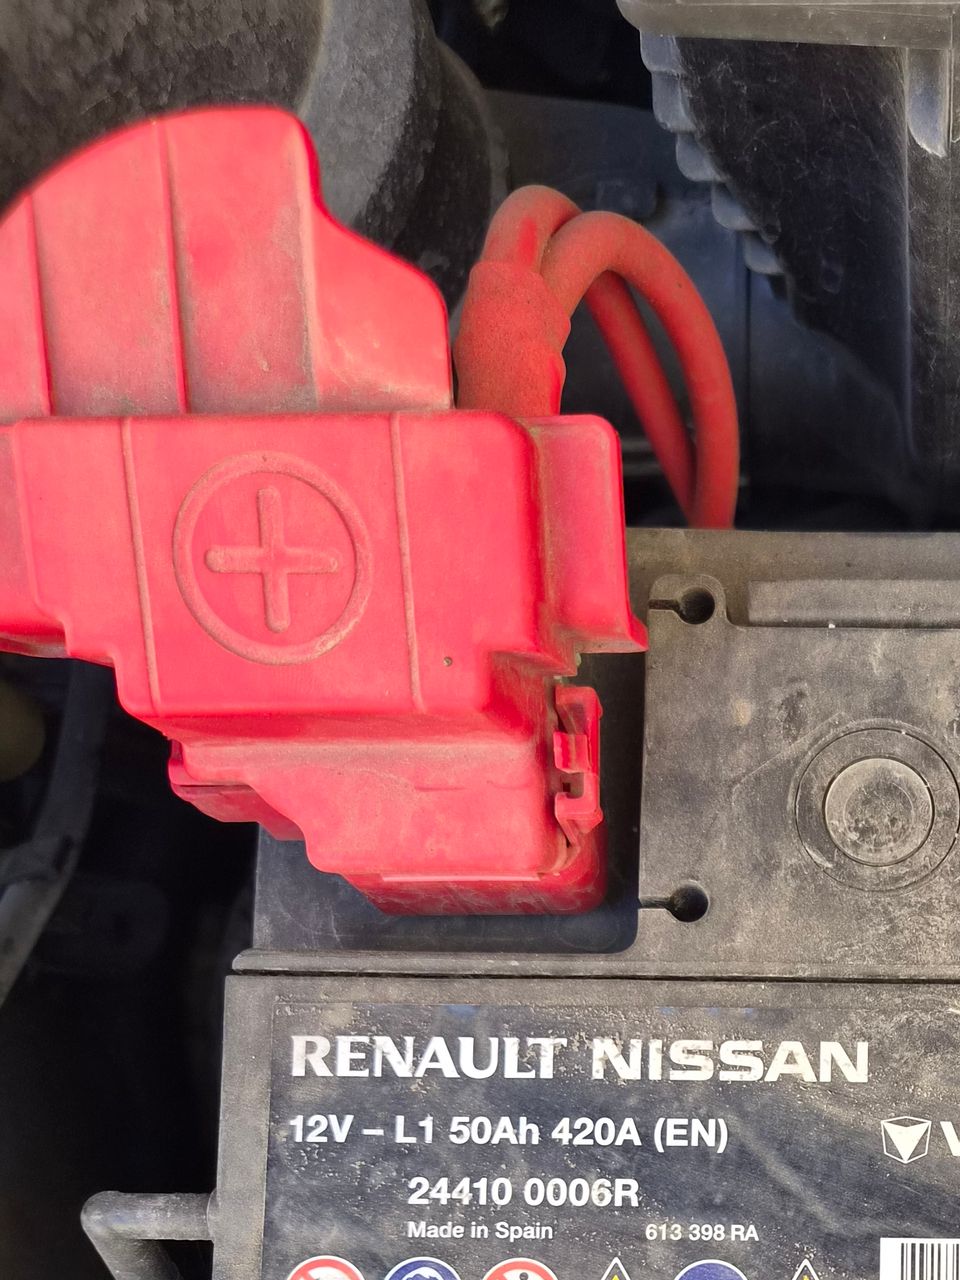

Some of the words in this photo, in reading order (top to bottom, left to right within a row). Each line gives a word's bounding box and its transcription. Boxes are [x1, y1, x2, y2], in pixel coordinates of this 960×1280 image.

[291, 1035, 568, 1079] RENAULT
[592, 1039, 869, 1083] NISSAN
[289, 1114, 354, 1143] 12V
[395, 1115, 434, 1144] L1
[450, 1116, 540, 1145] 50Ah
[551, 1117, 642, 1146] 420A
[653, 1118, 729, 1153] (EN)
[407, 1177, 513, 1206] 24410
[523, 1178, 640, 1207] 0006R
[407, 1221, 465, 1239] Made
[471, 1222, 489, 1239] in
[495, 1222, 553, 1242] Spain
[645, 1223, 682, 1241] 613
[688, 1224, 725, 1241] 398
[730, 1224, 760, 1242] RA
